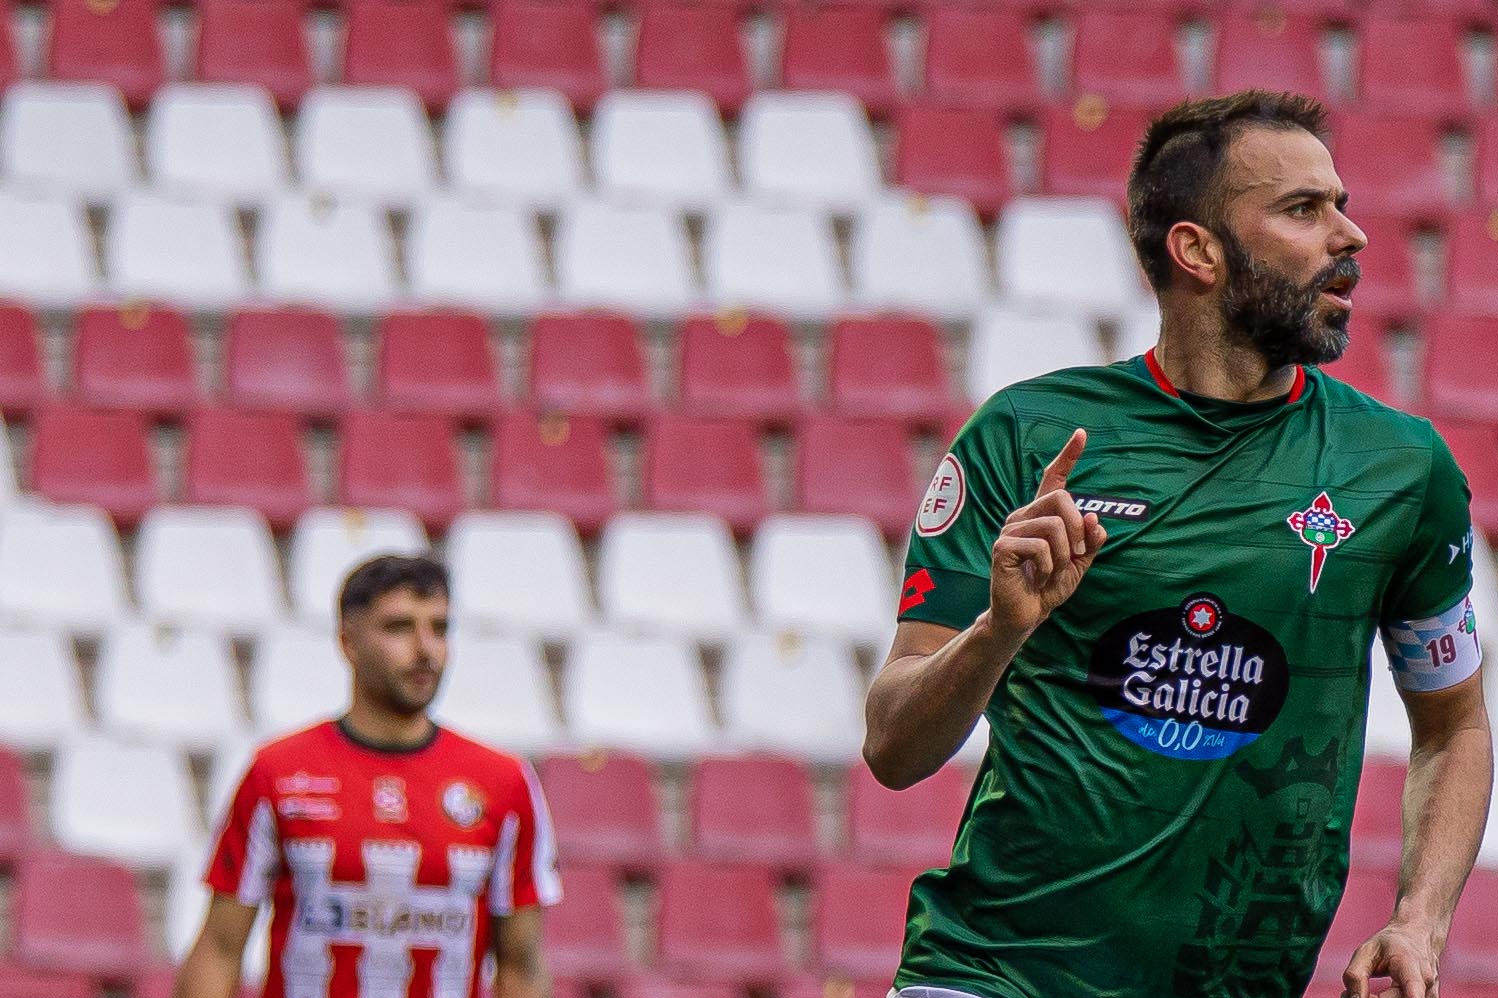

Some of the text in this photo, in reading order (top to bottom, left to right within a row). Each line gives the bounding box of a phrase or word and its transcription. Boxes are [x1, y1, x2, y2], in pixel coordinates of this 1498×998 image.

[923, 497, 949, 514] EF
[1076, 498, 1147, 516] LOTTO
[1123, 632, 1265, 685] Estrella
[1426, 634, 1457, 668] 19
[1122, 671, 1251, 723] Galicia
[1158, 718, 1203, 750] 0,0
